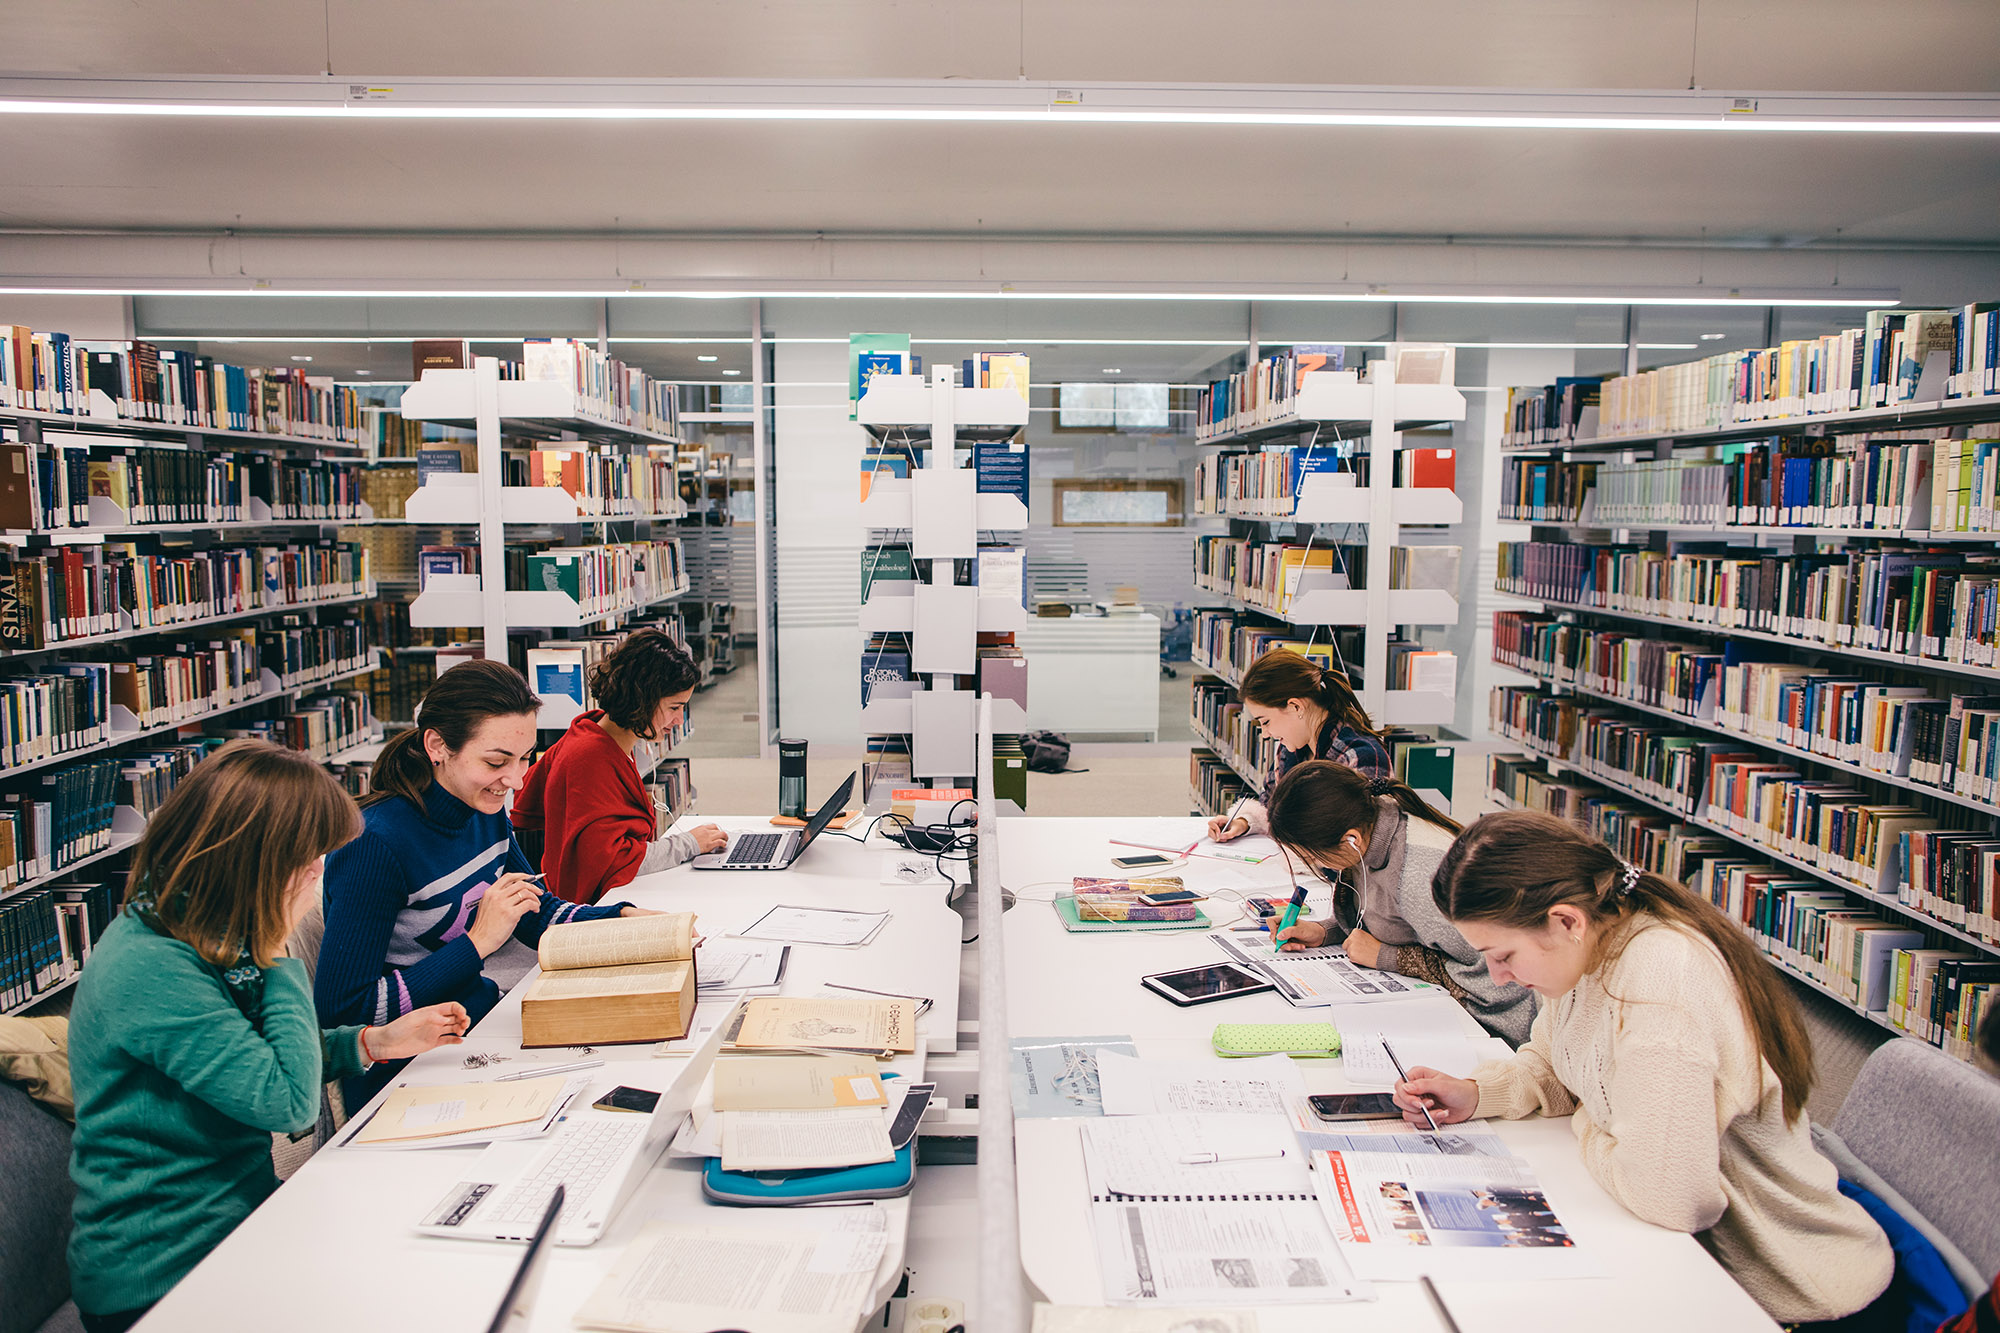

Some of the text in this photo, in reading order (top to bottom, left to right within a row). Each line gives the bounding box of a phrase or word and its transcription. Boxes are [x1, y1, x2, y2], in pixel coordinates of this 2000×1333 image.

[862, 552, 891, 560] Hanuch
[862, 564, 908, 573] Pasraltheologie
[0, 575, 20, 639] SINAI
[1333, 1158, 1366, 1237] 3A The truth about air travel
